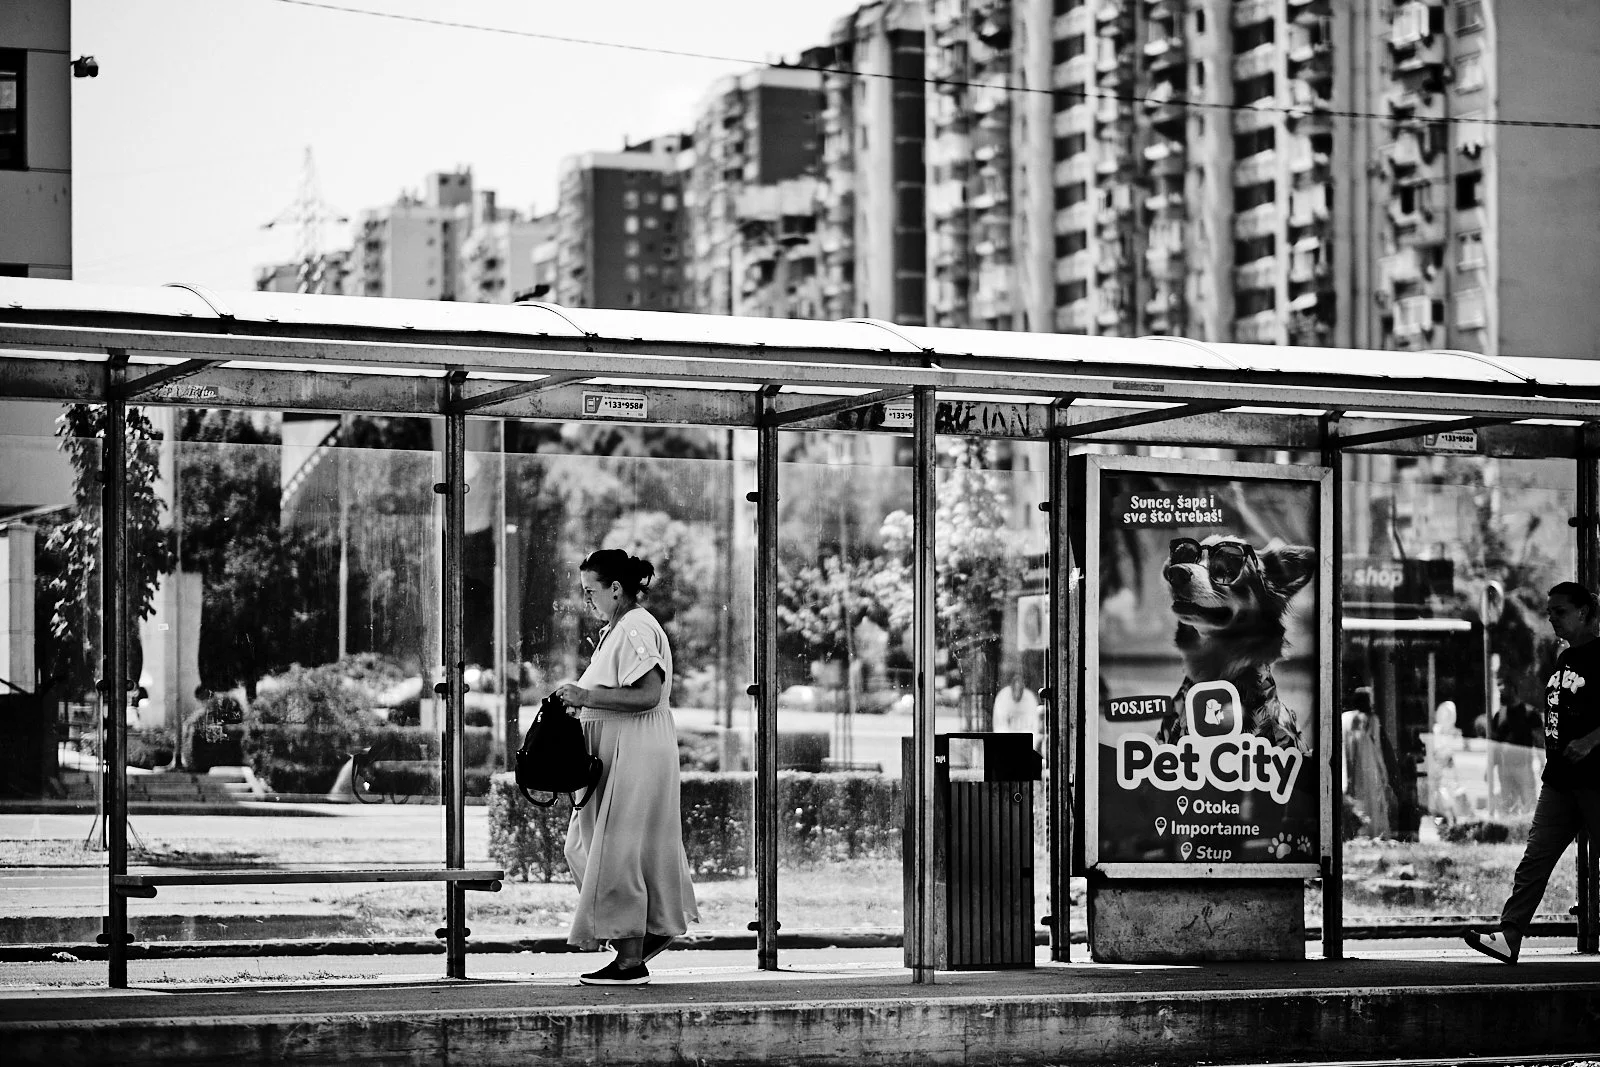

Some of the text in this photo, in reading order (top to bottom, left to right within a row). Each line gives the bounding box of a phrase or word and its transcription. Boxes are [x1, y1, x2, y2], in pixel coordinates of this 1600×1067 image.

[889, 412, 914, 420] 1339
[1130, 494, 1215, 512] Sunce, šape i
[1123, 508, 1222, 523] sve što trebaš!
[1354, 566, 1404, 591] shop
[1110, 698, 1166, 716] POSJETI
[1122, 739, 1298, 796] Pet City
[1192, 799, 1240, 815] Otoka
[1171, 820, 1260, 838] Importanne
[1196, 845, 1232, 862] Stup
